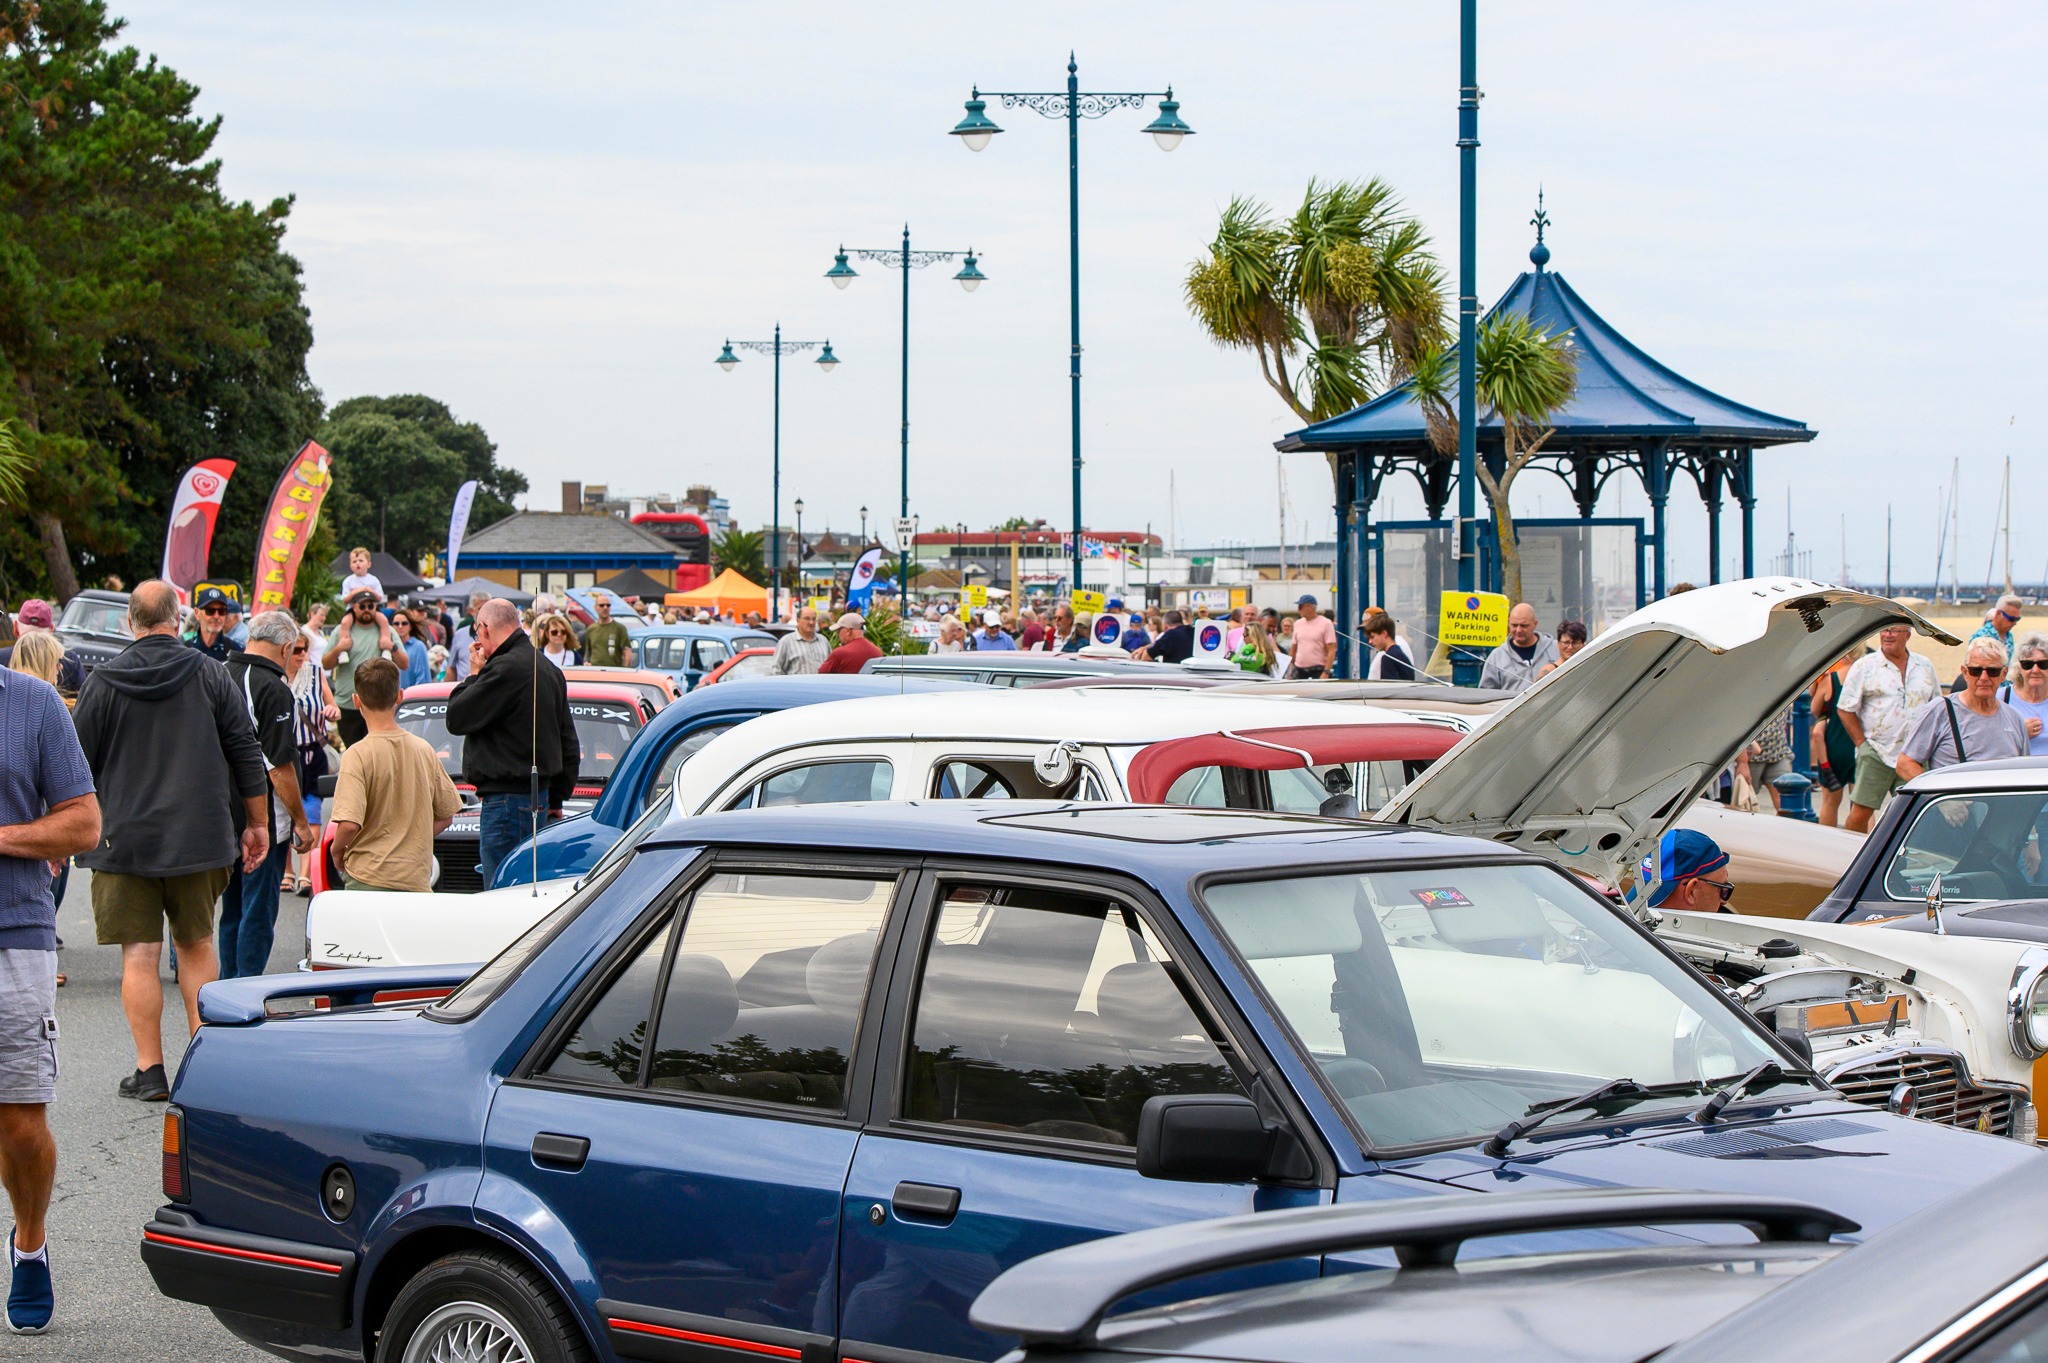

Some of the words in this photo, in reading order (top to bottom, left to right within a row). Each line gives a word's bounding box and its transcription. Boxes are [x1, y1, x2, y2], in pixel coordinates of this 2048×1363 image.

[259, 485, 313, 605] BURGER
[1074, 600, 1100, 608] WARNING
[1447, 611, 1498, 622] WARNING
[1454, 622, 1490, 632] Parking
[1445, 633, 1497, 642] suspension
[429, 705, 448, 715] co
